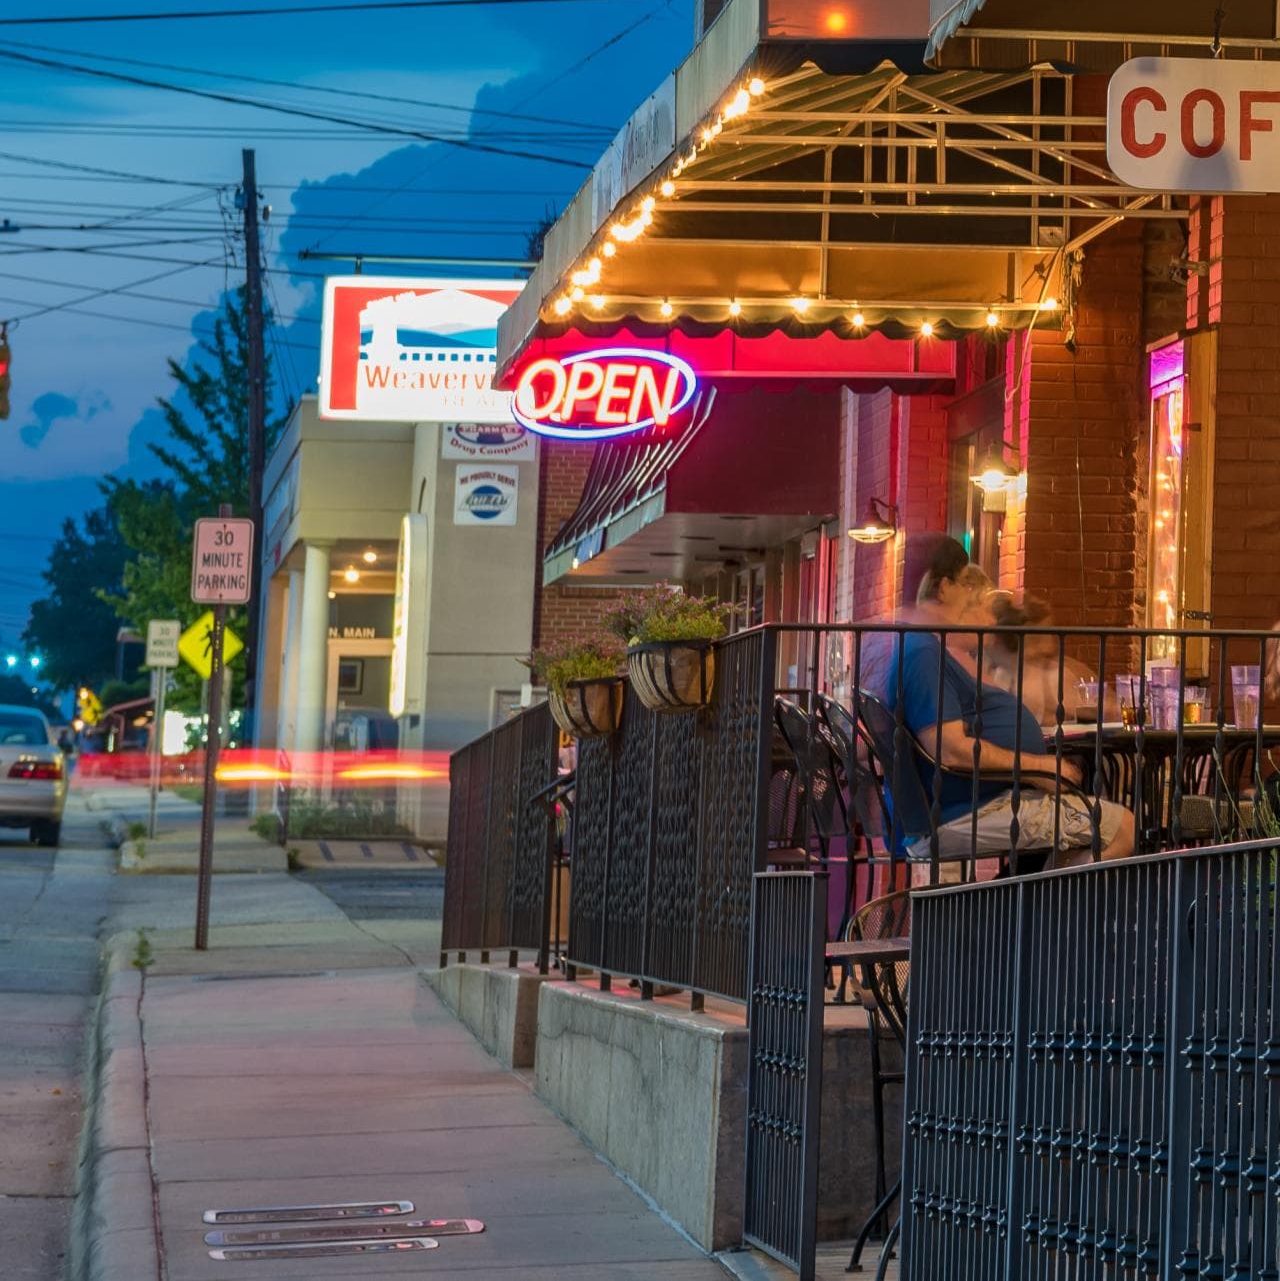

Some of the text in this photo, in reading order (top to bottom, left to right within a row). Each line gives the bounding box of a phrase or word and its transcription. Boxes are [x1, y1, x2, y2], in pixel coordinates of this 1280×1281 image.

[365, 364, 496, 391] Weaverv
[515, 358, 680, 425] OPEN
[450, 438, 529, 456] Drug Company
[214, 530, 234, 546] 30
[202, 552, 243, 568] MINUTE
[197, 574, 245, 591] PARKING
[343, 627, 376, 639] MAIN
